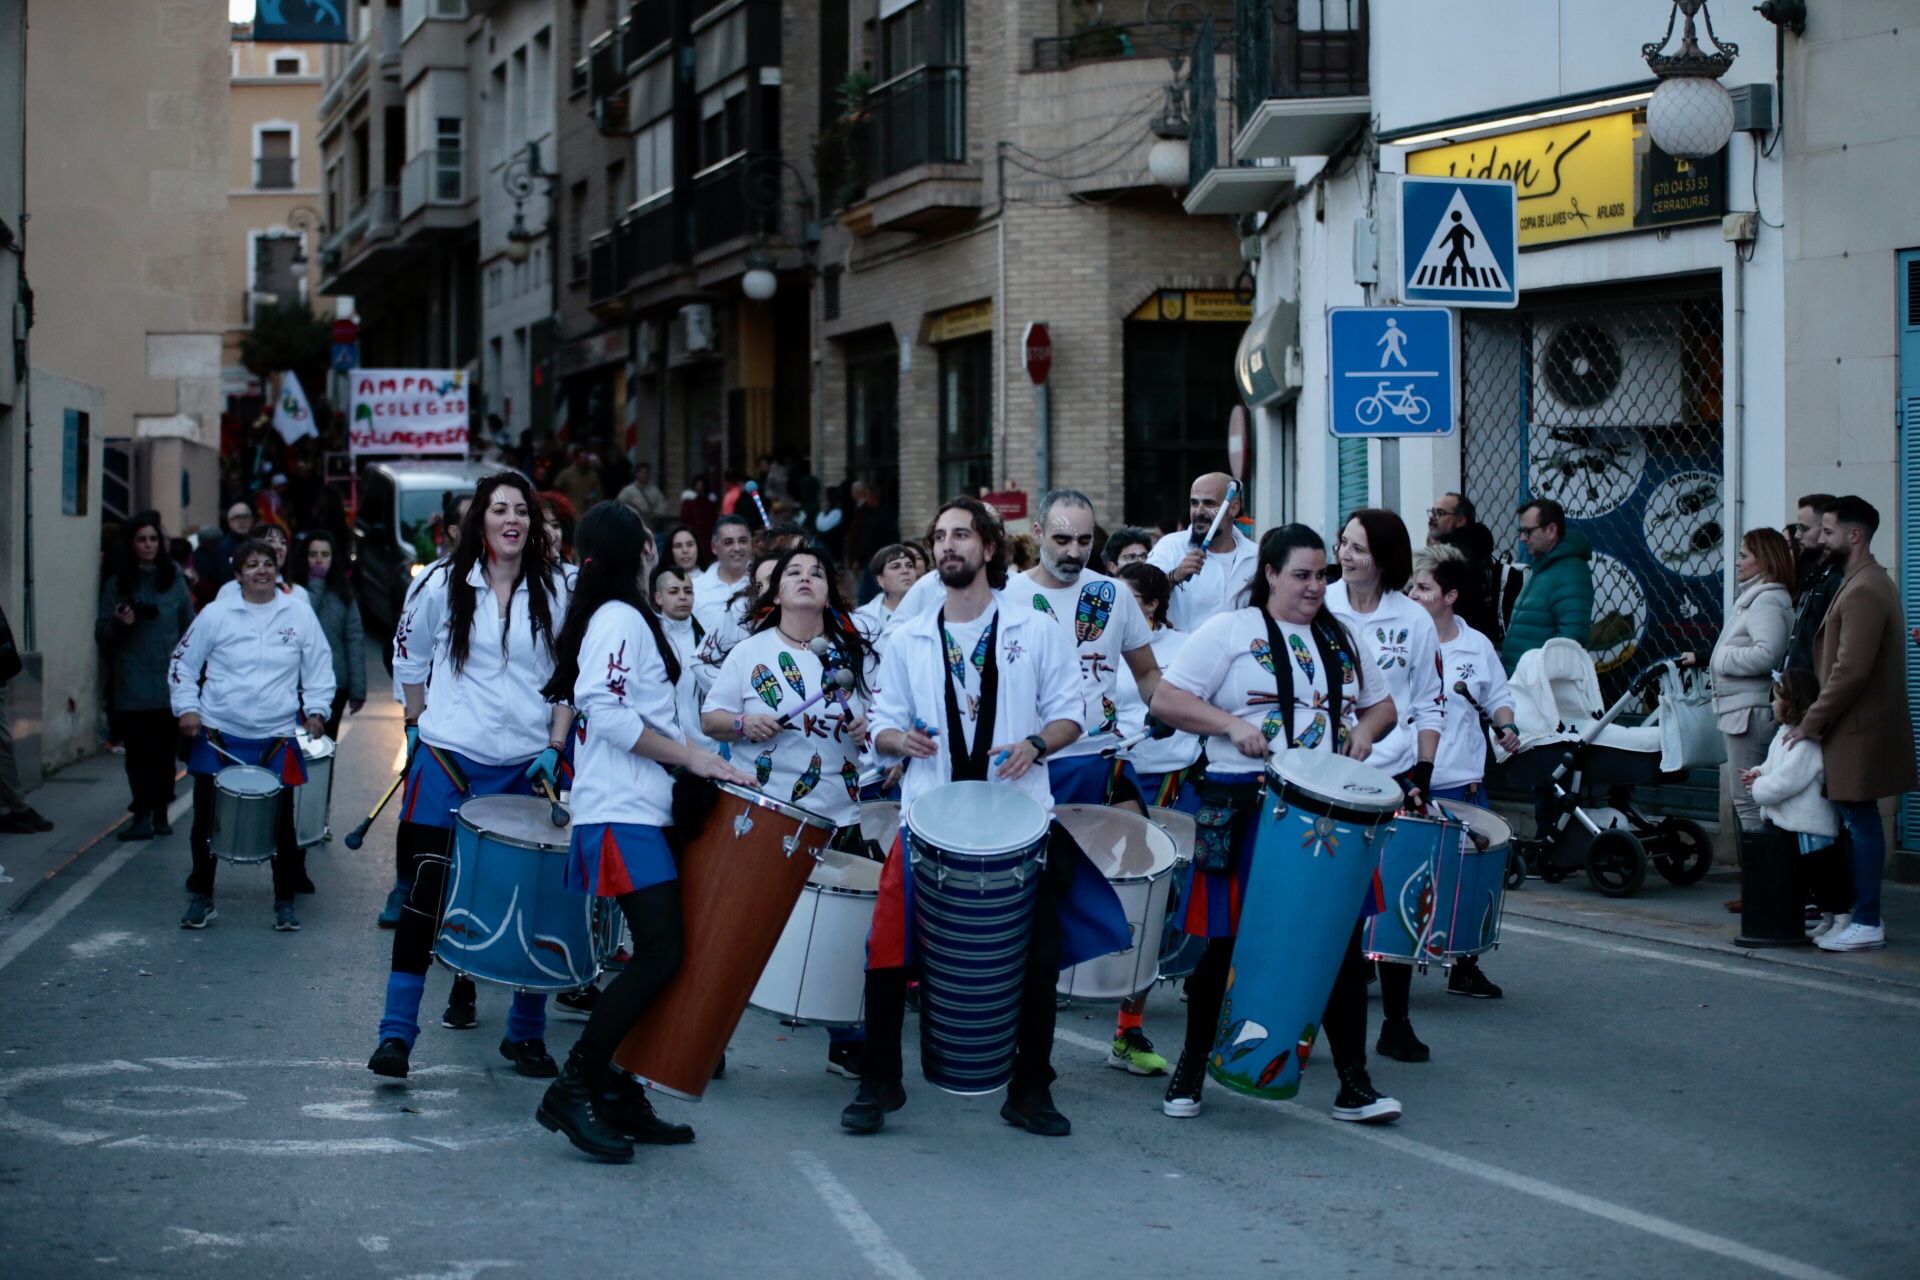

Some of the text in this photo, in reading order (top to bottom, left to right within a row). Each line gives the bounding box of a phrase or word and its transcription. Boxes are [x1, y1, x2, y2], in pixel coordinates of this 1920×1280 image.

[1653, 182, 1669, 197] 670
[1685, 178, 1696, 192] 53
[1697, 176, 1709, 190] 53
[1596, 202, 1625, 219] AFILADOS
[1652, 193, 1710, 214] CERRADURAS
[1520, 210, 1567, 231] COPIA DE LLAVES
[358, 377, 434, 395] AMPA
[375, 400, 465, 417] COLEGIO
